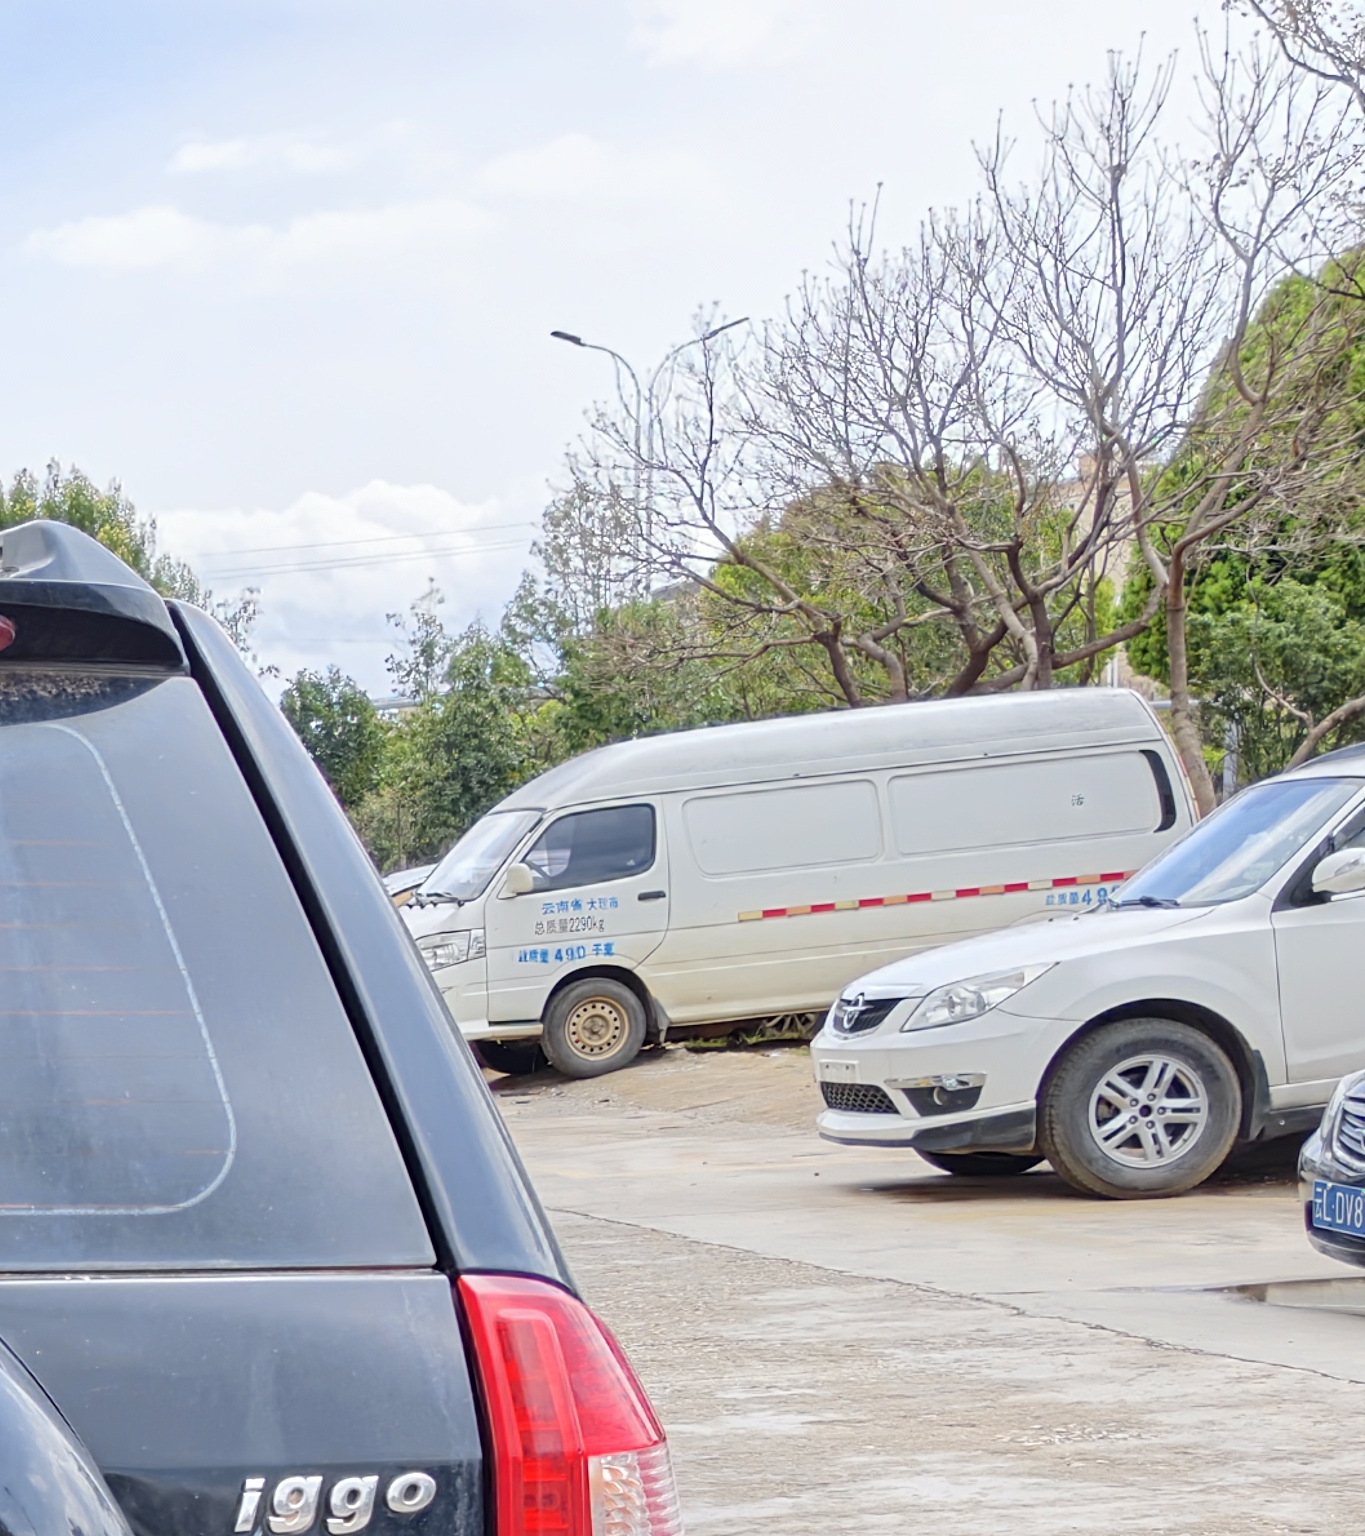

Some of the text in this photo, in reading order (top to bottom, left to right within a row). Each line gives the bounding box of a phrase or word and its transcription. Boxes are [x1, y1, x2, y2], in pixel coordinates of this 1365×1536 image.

[541, 898, 583, 915] 云南省
[554, 945, 587, 962] 490
[233, 1471, 438, 1535] iggo
